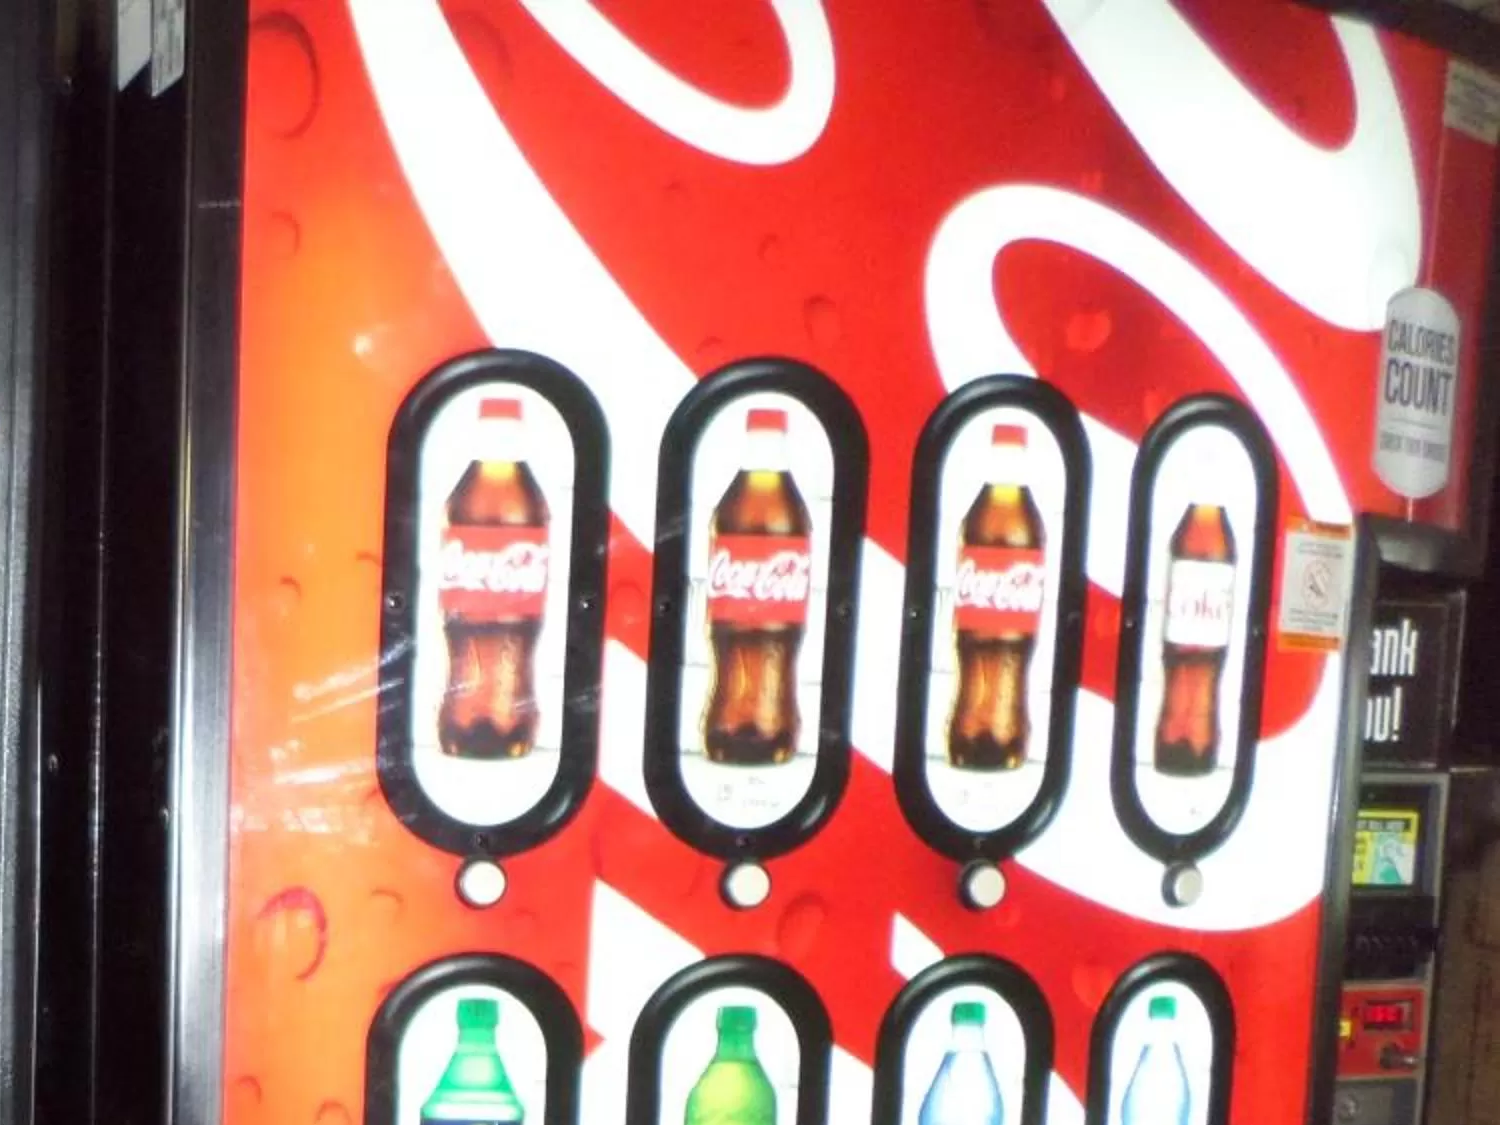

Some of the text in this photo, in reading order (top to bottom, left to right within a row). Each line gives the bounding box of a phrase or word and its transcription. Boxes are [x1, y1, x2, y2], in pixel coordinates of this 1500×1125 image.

[1387, 318, 1456, 366] CALORIES
[1384, 359, 1454, 417] COUNT
[709, 548, 812, 601] Coca-Cola
